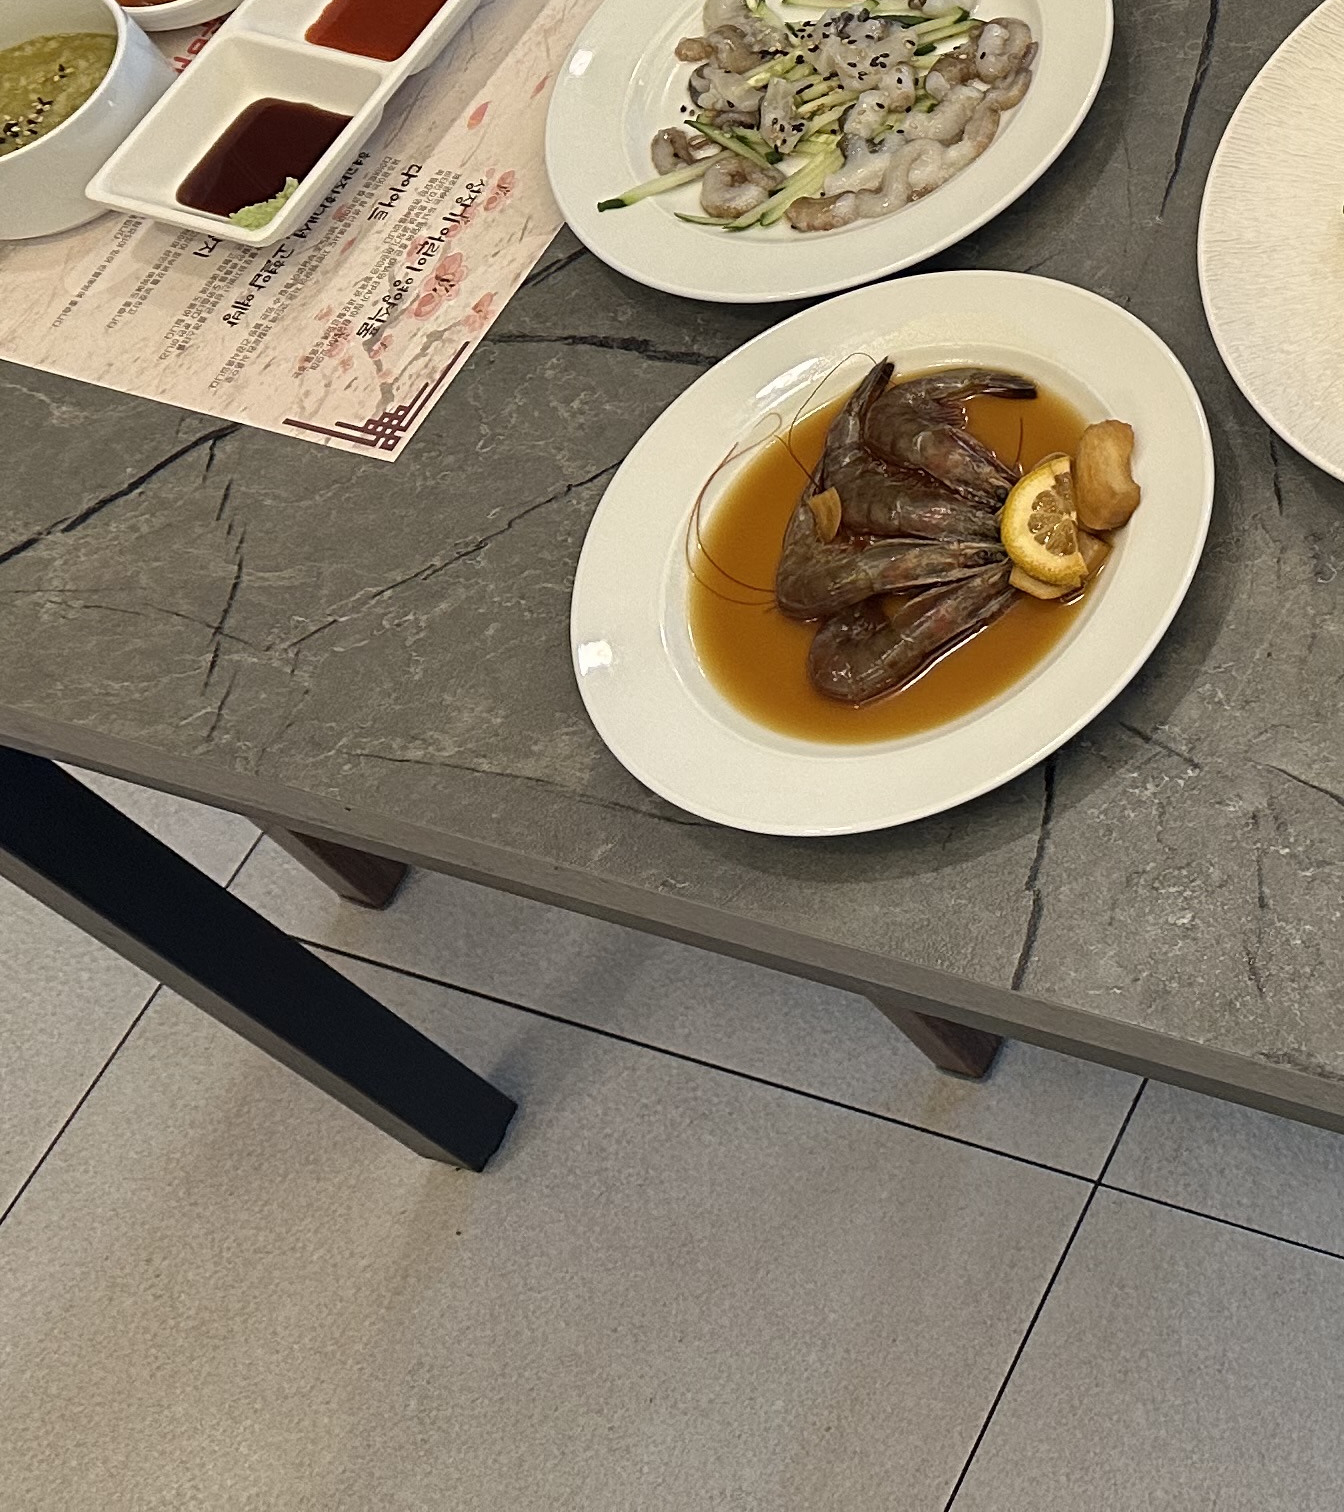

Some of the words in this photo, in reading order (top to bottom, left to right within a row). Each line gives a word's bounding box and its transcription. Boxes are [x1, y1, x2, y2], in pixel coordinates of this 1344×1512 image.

[366, 162, 423, 223] 다이어트
[440, 176, 489, 224] 성장기
[245, 242, 296, 292] 고혈압
[404, 224, 453, 273] 어린이
[225, 289, 258, 327] 예방
[356, 274, 415, 340] 영양식품
